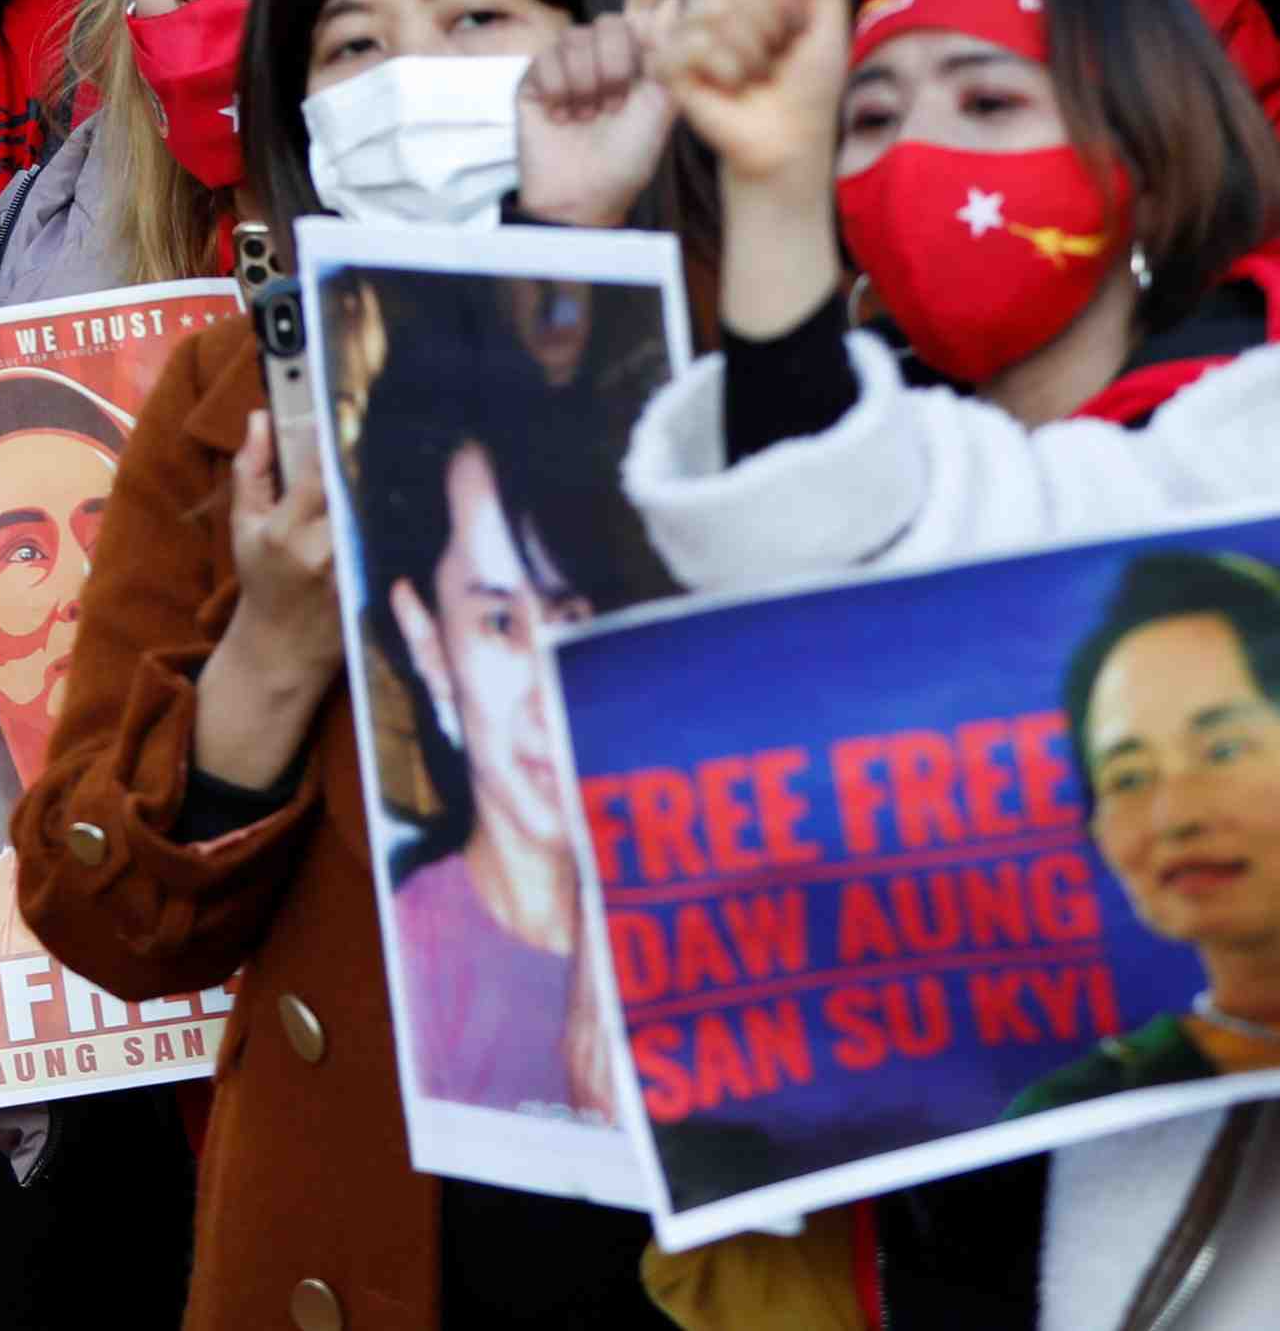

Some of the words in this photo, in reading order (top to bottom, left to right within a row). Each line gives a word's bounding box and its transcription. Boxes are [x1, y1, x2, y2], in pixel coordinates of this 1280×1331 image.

[15, 325, 58, 355] WE
[72, 309, 165, 347] TRUST
[581, 747, 820, 882] FREE
[831, 711, 1084, 854] FREE
[607, 887, 806, 1004] DAW
[838, 852, 1100, 962] AUNG
[123, 1027, 206, 1066] SAN
[630, 1000, 813, 1125] SAN
[824, 977, 952, 1070] SU
[968, 964, 1120, 1048] KYI
